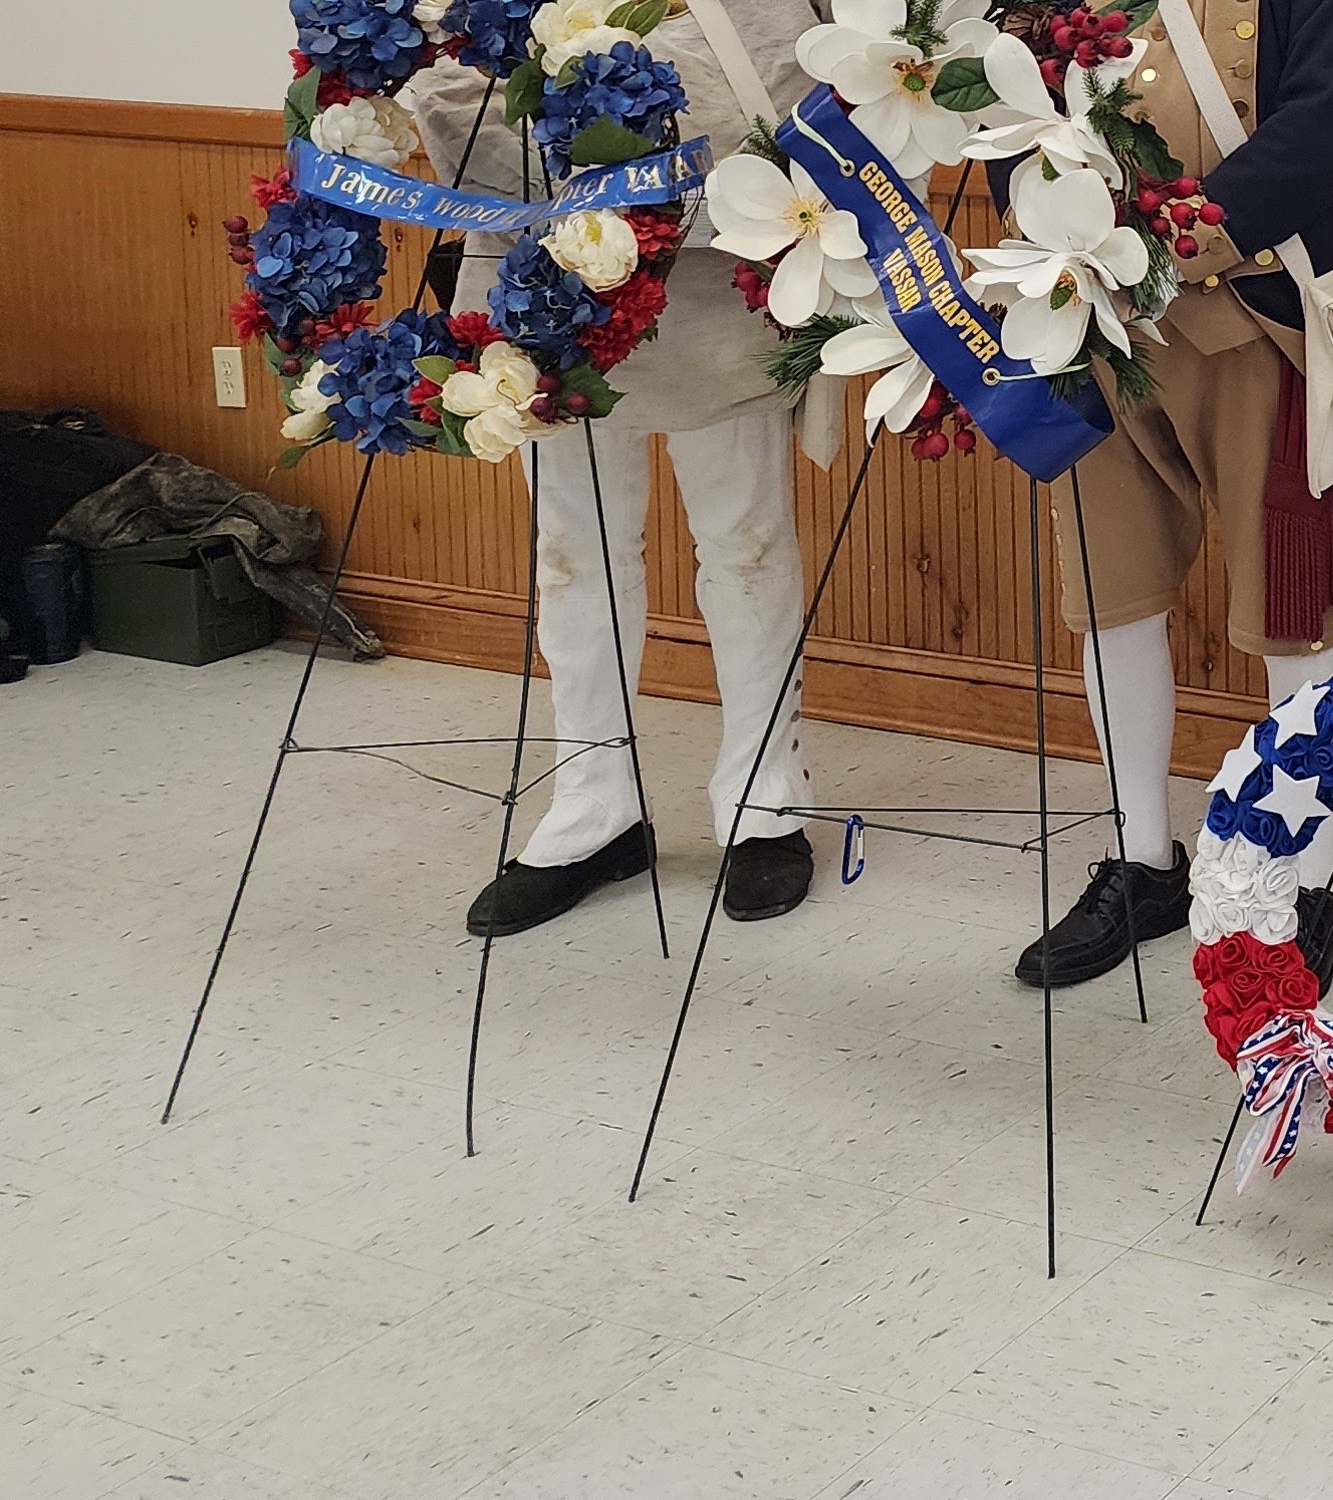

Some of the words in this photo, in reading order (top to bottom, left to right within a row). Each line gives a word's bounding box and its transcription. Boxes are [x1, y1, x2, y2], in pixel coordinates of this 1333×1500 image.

[321, 163, 423, 210] James
[858, 161, 918, 233] GEORGE
[904, 225, 945, 286] MASON
[928, 280, 1000, 364] CHAPTER
[882, 247, 922, 313] VASSAR
